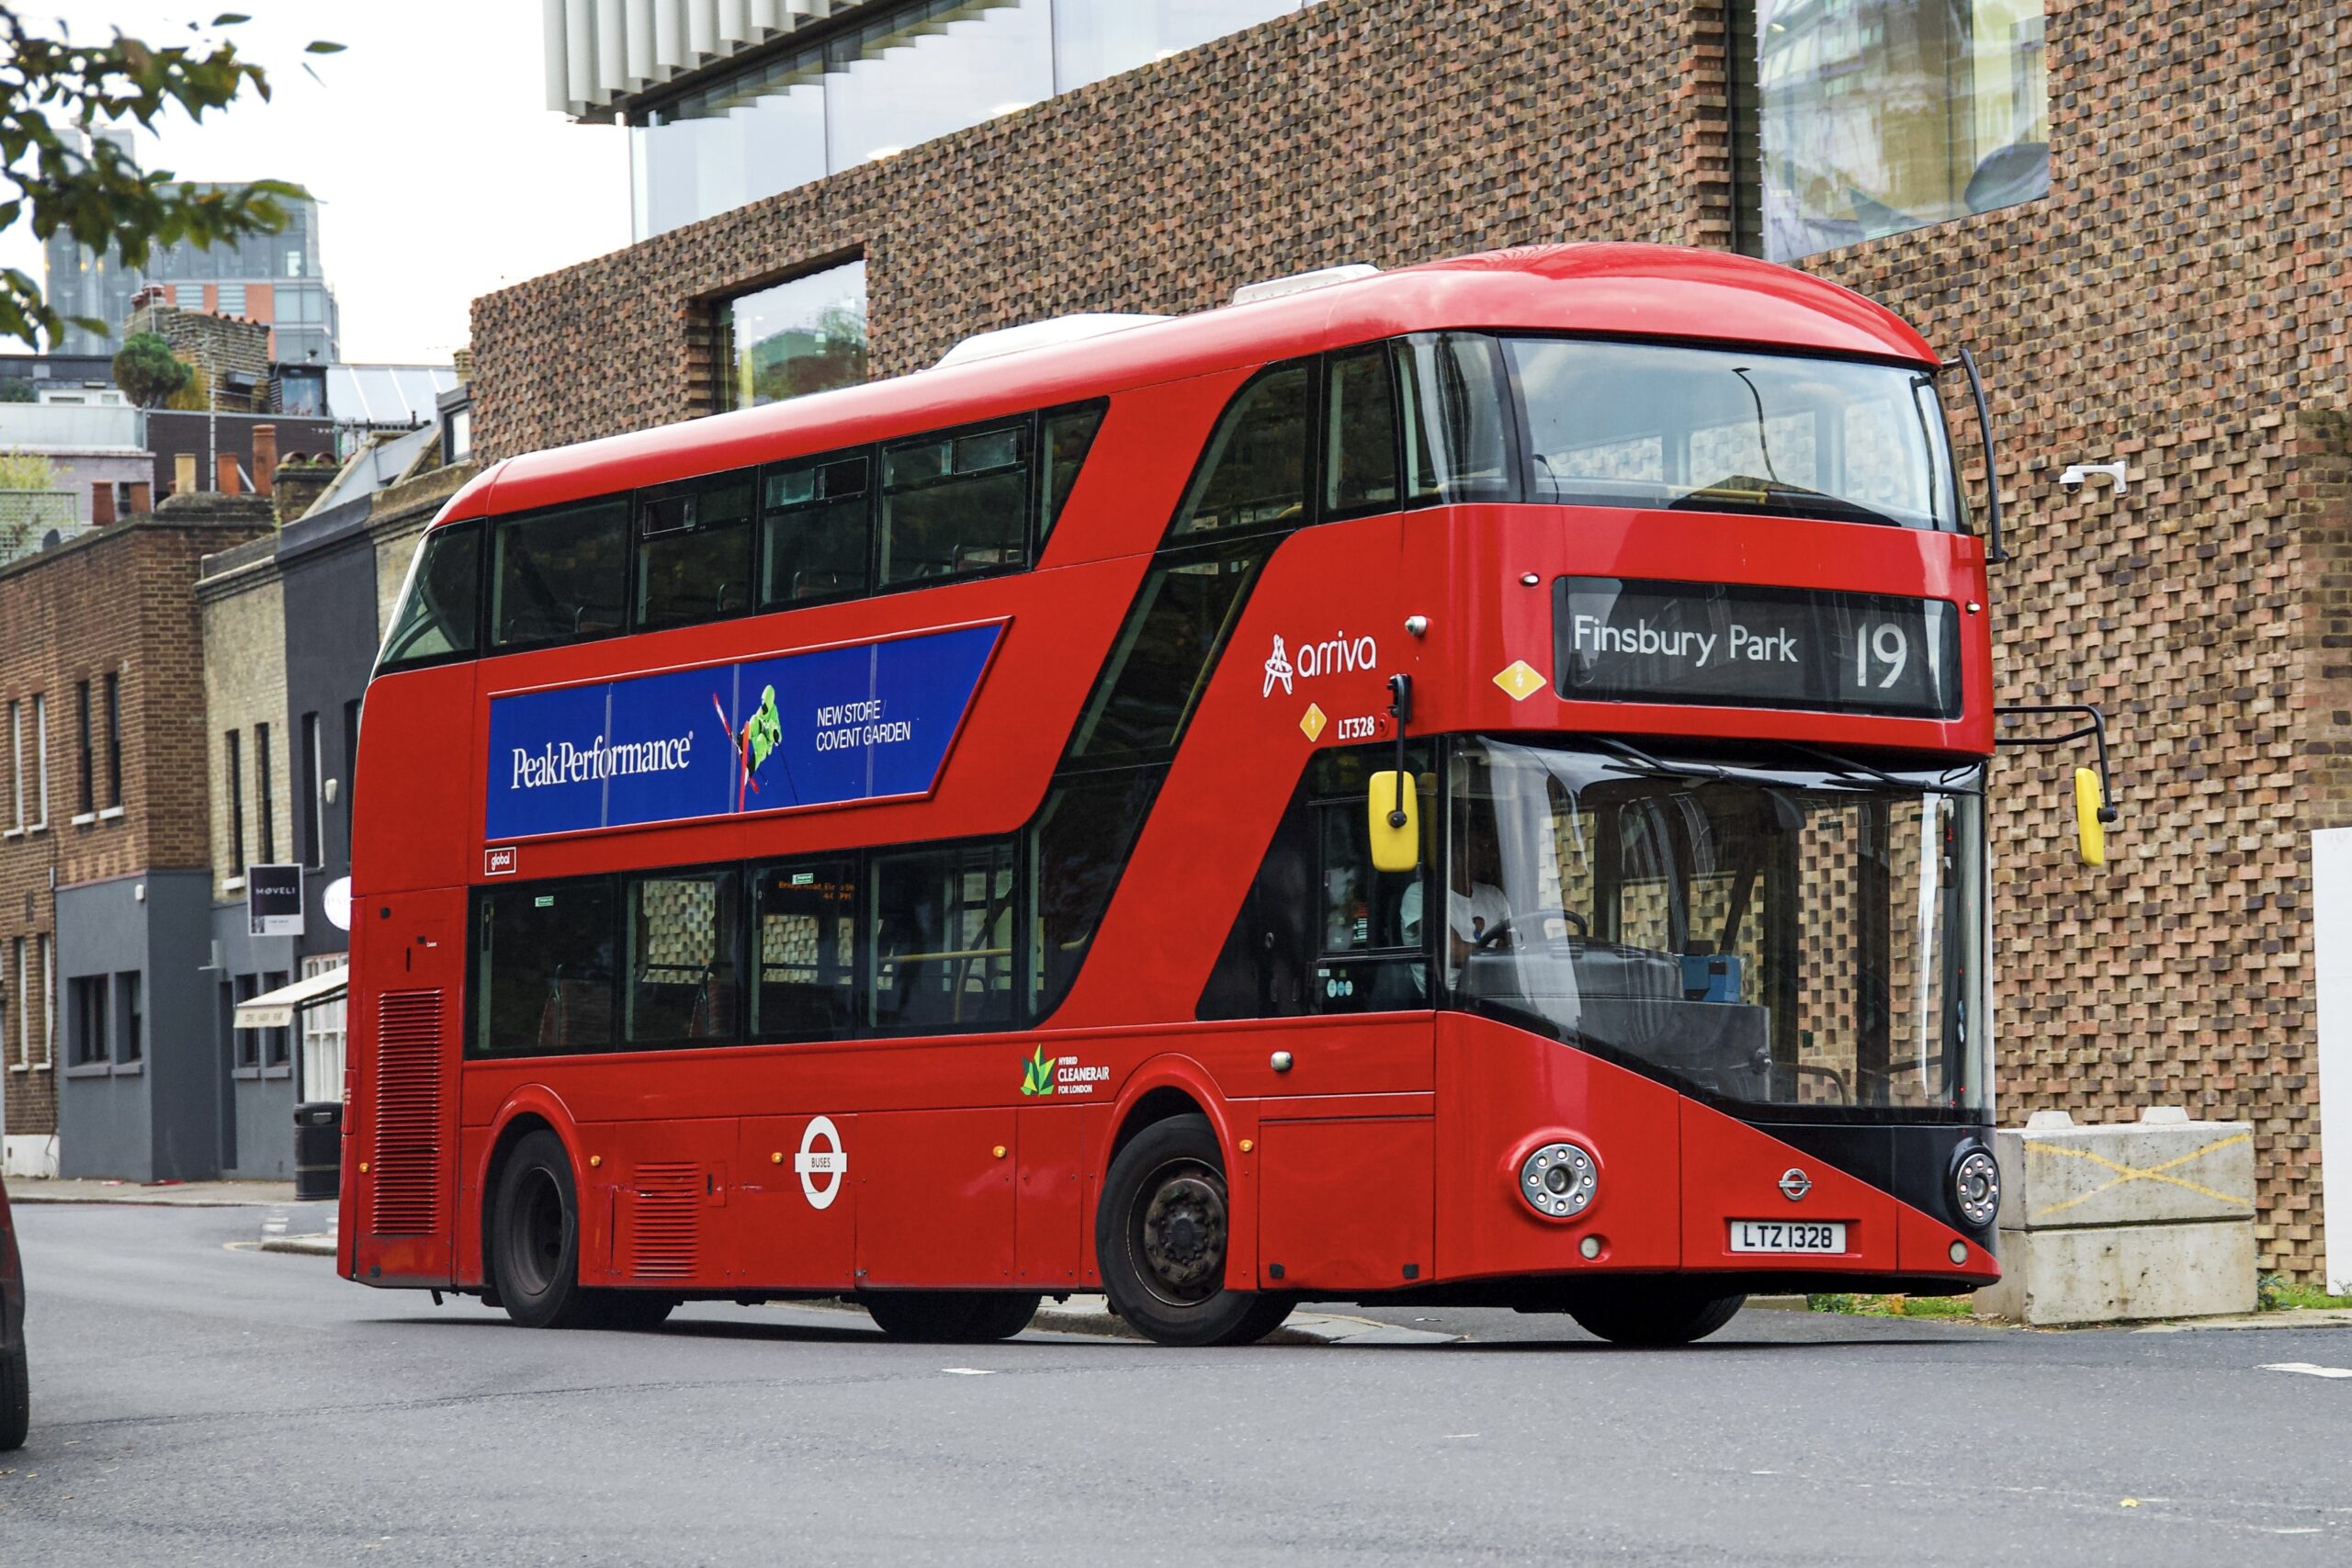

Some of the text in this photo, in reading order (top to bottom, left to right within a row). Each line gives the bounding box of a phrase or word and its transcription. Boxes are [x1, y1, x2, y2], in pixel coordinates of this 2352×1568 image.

[1574, 615, 1798, 668] Finsbury Park
[1297, 630, 1376, 678] arriva
[1857, 622, 1907, 689] 19
[817, 705, 843, 728] NEW
[1338, 716, 1375, 739] LT328
[816, 720, 911, 751] COVENT GARDEN
[491, 851, 510, 872] global
[1058, 1055, 1079, 1066] HYBRID
[1057, 1084, 1093, 1094] FOR LONDON
[810, 1156, 831, 1168] BUSES
[1744, 1224, 1782, 1247] LTZ
